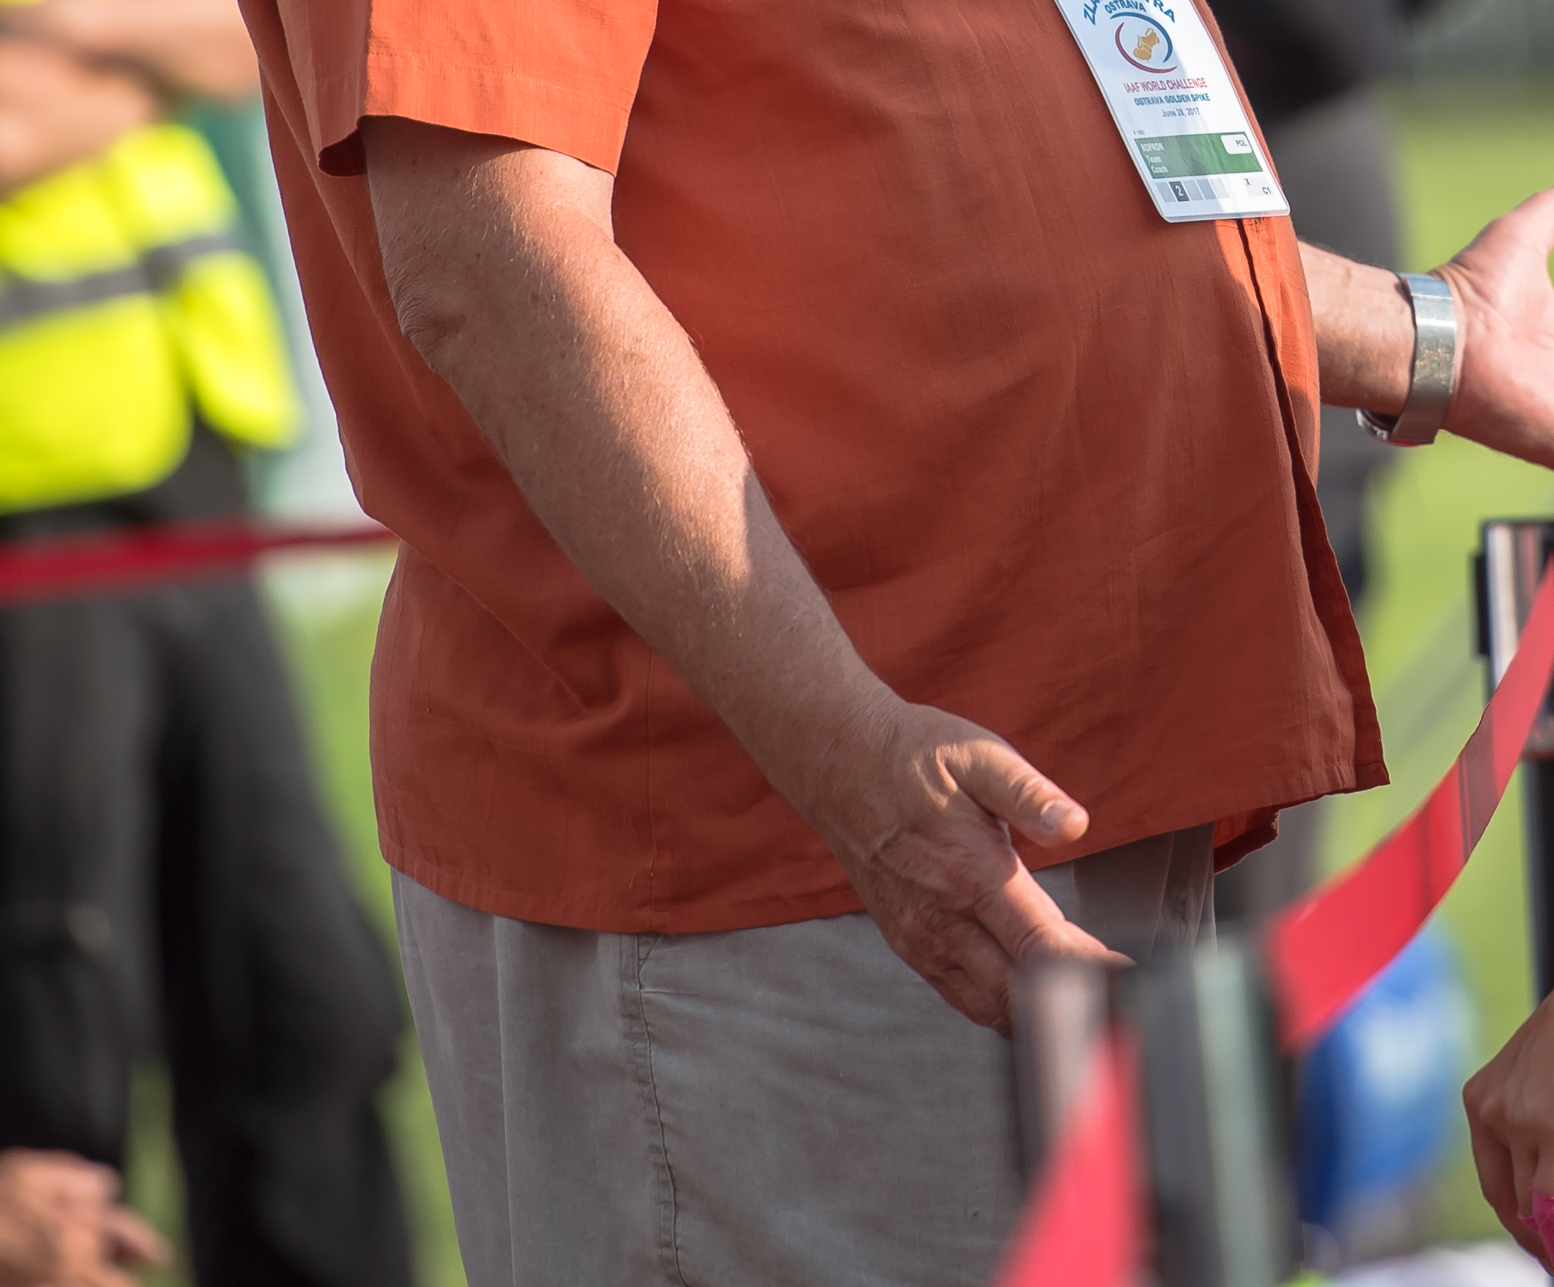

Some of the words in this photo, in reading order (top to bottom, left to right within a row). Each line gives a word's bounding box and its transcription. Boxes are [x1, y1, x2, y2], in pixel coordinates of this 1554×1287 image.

[1123, 81, 1140, 93] IAAF
[1140, 78, 1167, 92] WORLD
[1166, 77, 1208, 90] CHALLENGE
[1133, 95, 1165, 106] OSTRAVA
[1164, 93, 1191, 104] GOLDEN
[1190, 92, 1211, 102] SPIKE
[1150, 164, 1169, 174] Coach
[1174, 184, 1184, 197] 2
